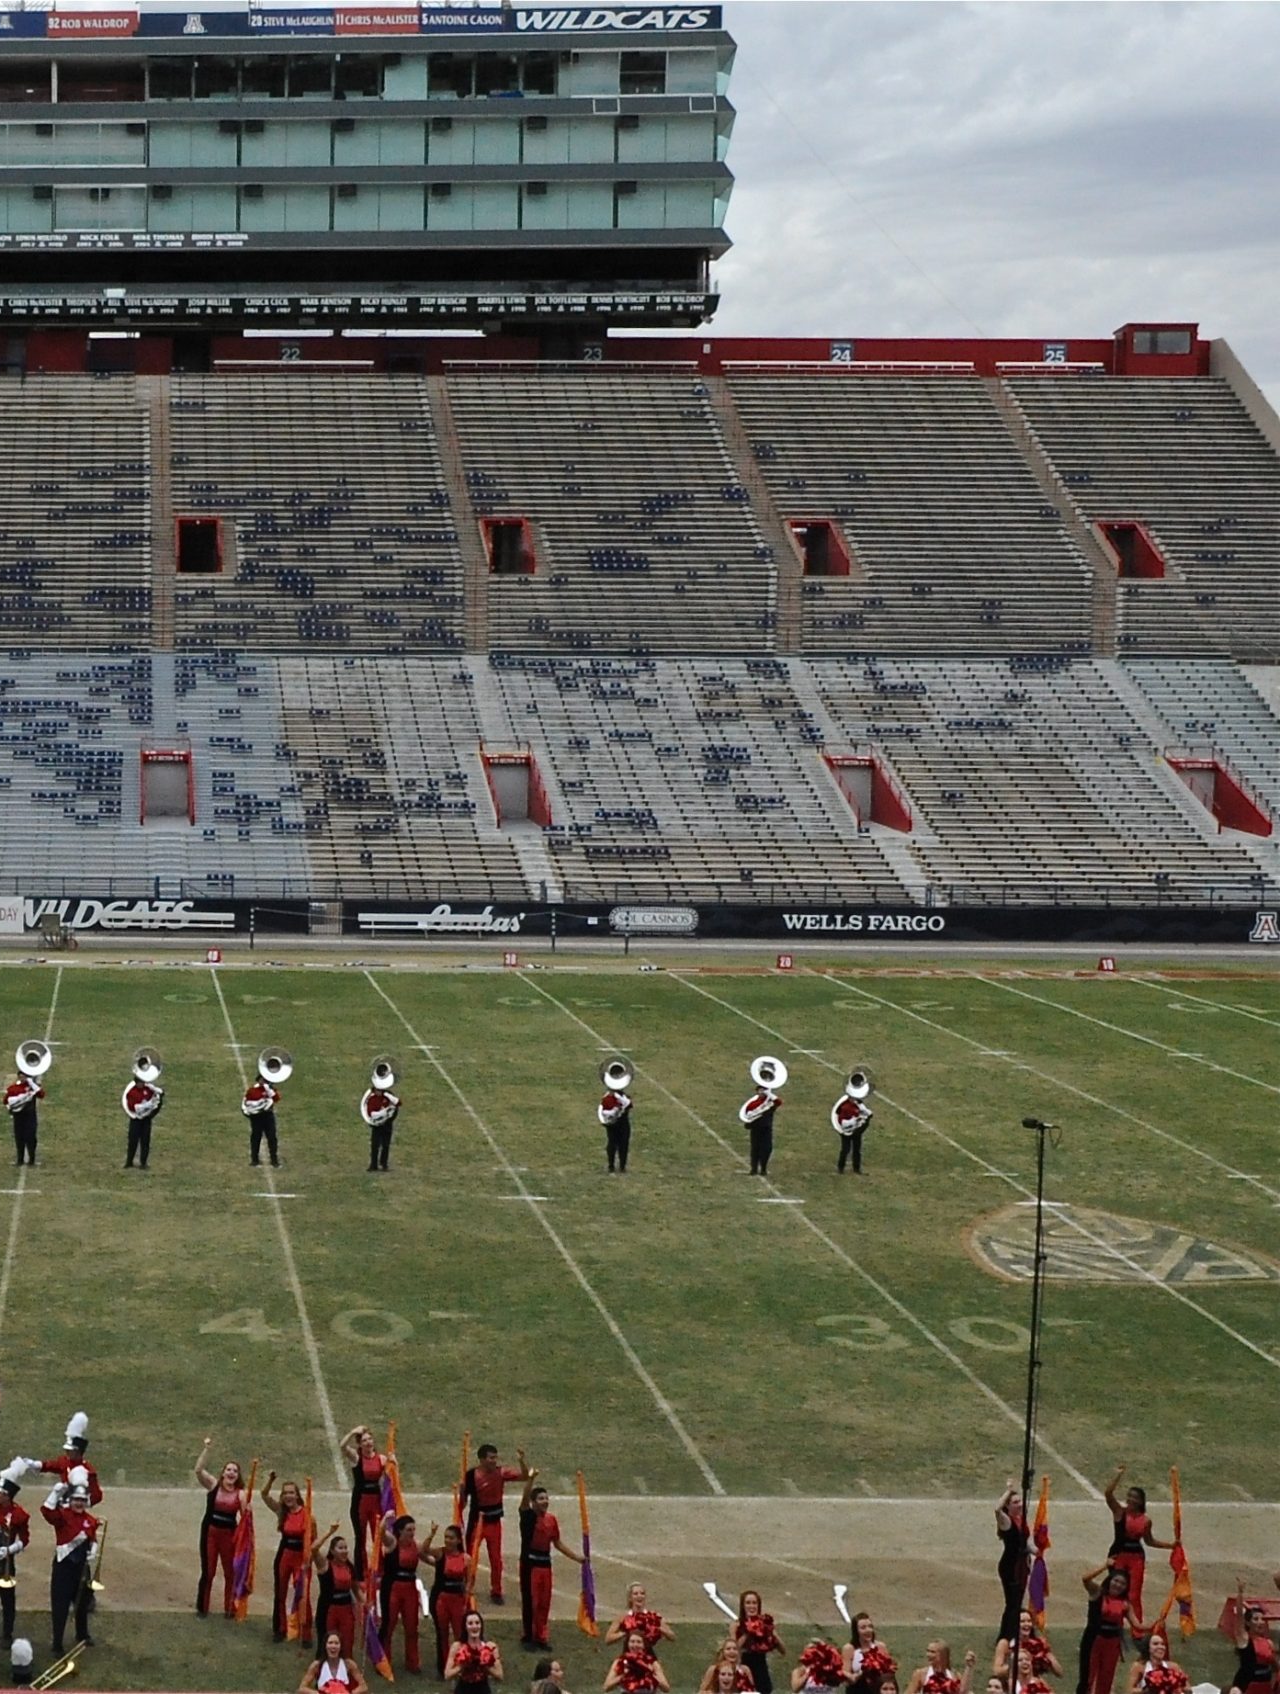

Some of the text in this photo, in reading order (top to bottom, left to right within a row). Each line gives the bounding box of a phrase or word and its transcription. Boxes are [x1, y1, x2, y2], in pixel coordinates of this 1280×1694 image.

[61, 19, 80, 29] ROB
[83, 19, 129, 29] WALDROP
[264, 16, 284, 27] STEVE
[345, 14, 371, 25] CHRIS
[429, 14, 468, 25] ANTOINE
[470, 14, 502, 25] CASON
[516, 10, 710, 30] WILDCATS
[281, 348, 301, 361] 22
[583, 348, 602, 361] 23
[831, 349, 851, 362] 24
[1046, 350, 1065, 363] 25
[0, 907, 18, 922] DAY
[642, 915, 690, 924] CASINOS
[783, 914, 945, 932] WELLS FARGO
